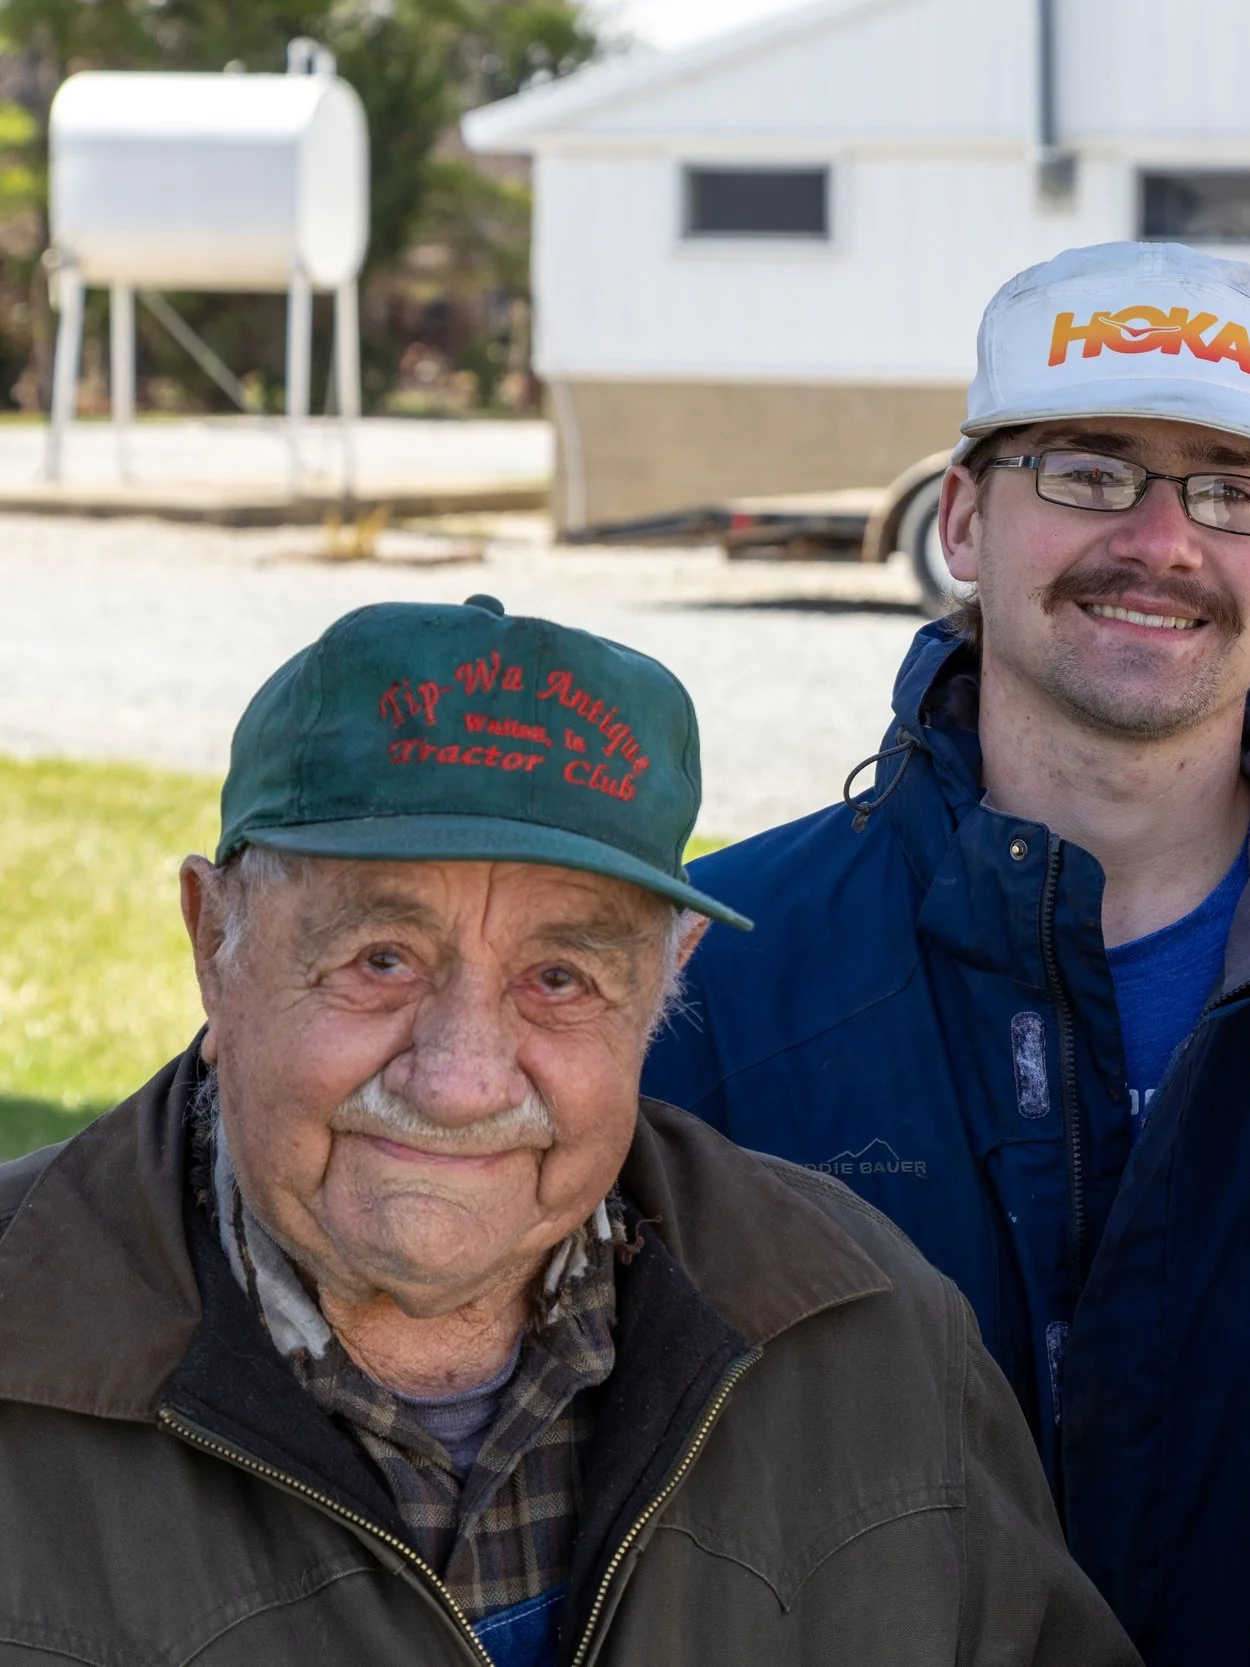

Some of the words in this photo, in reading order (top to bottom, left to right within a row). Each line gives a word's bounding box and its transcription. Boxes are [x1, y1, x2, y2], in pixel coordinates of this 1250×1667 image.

[537, 669, 649, 775] Antique
[388, 738, 545, 771] Tractor
[563, 760, 637, 801] Club
[859, 1161, 927, 1174] BAUER
